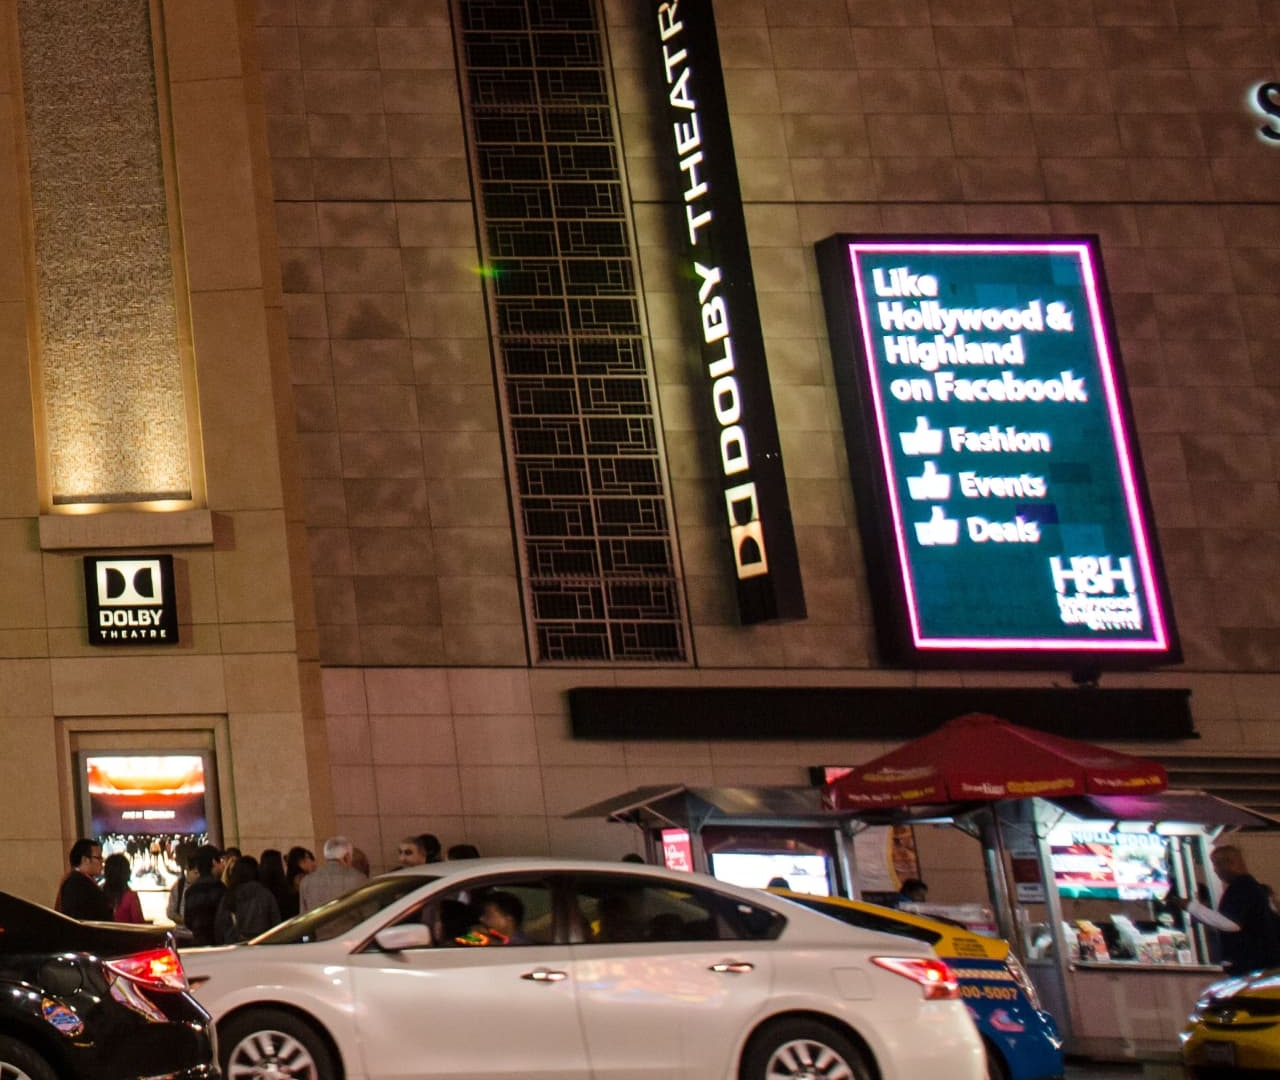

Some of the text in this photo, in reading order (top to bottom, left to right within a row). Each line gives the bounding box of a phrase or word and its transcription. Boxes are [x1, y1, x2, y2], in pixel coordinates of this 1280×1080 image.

[872, 266, 939, 298] Like
[877, 299, 1074, 337] Hollywood &
[883, 333, 1025, 371] Highland
[694, 261, 750, 477] DOLBY
[890, 370, 1088, 402] on Facebook
[948, 425, 1053, 453] Fashion
[958, 470, 1048, 498] Events
[966, 515, 1041, 543] Deals
[1049, 555, 1137, 594] H&H
[99, 609, 163, 627] DOLBY
[100, 629, 167, 639] THEATRE
[958, 984, 1018, 1000] 00-5007
